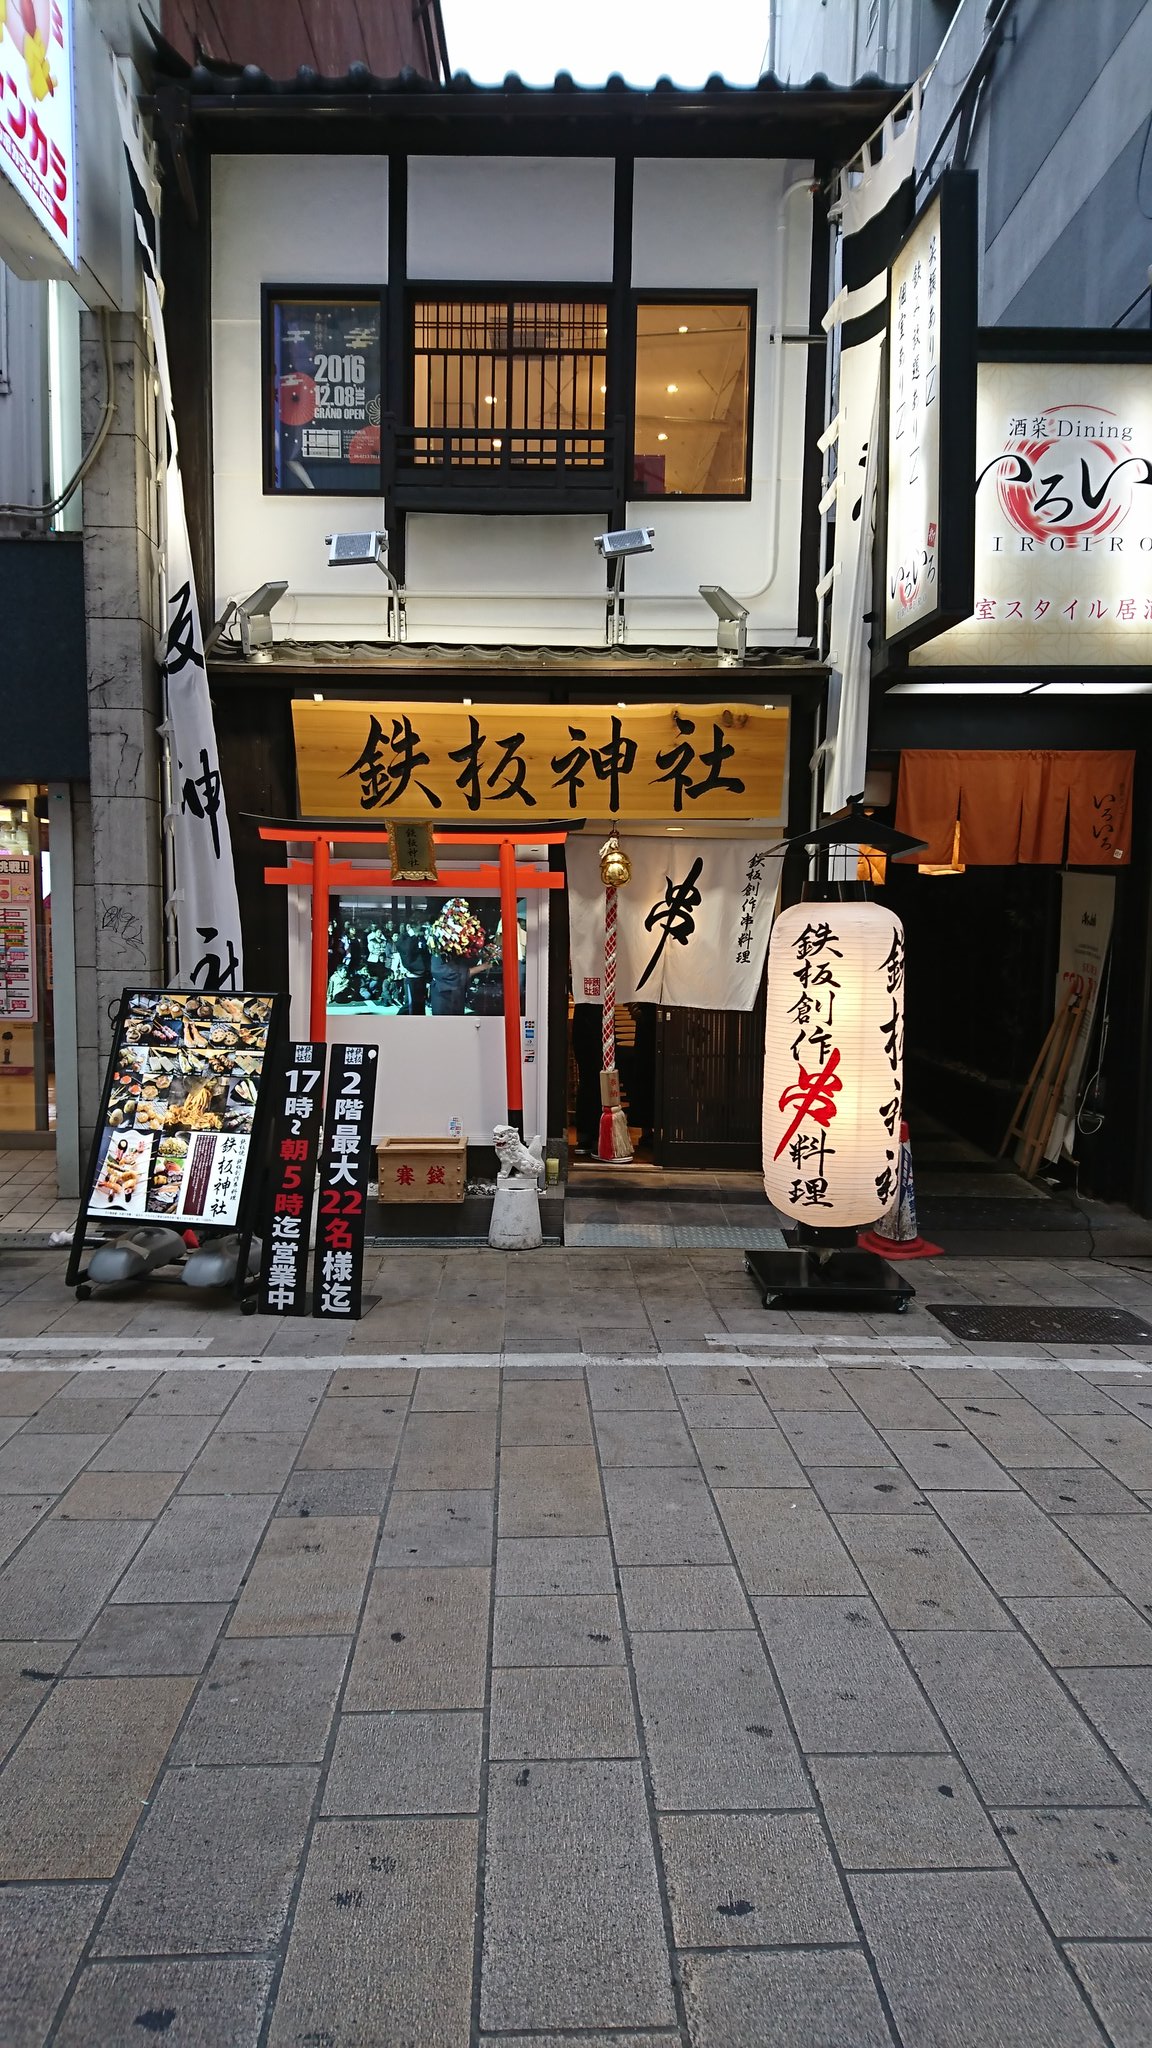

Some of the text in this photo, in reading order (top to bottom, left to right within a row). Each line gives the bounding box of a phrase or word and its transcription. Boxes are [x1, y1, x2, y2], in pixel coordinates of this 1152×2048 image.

[314, 354, 366, 384] 2016
[314, 385, 355, 408] 12.08
[355, 386, 366, 407] TUE
[314, 407, 366, 420] GRAND OPEN
[1008, 417, 1134, 442] 酒菜 Dining
[337, 713, 746, 813] 鉄板神社
[1093, 793, 1116, 851] いろいろ
[210, 1136, 238, 1218] 鉄板神社
[320, 1071, 364, 1313] 2階最大22名様迄
